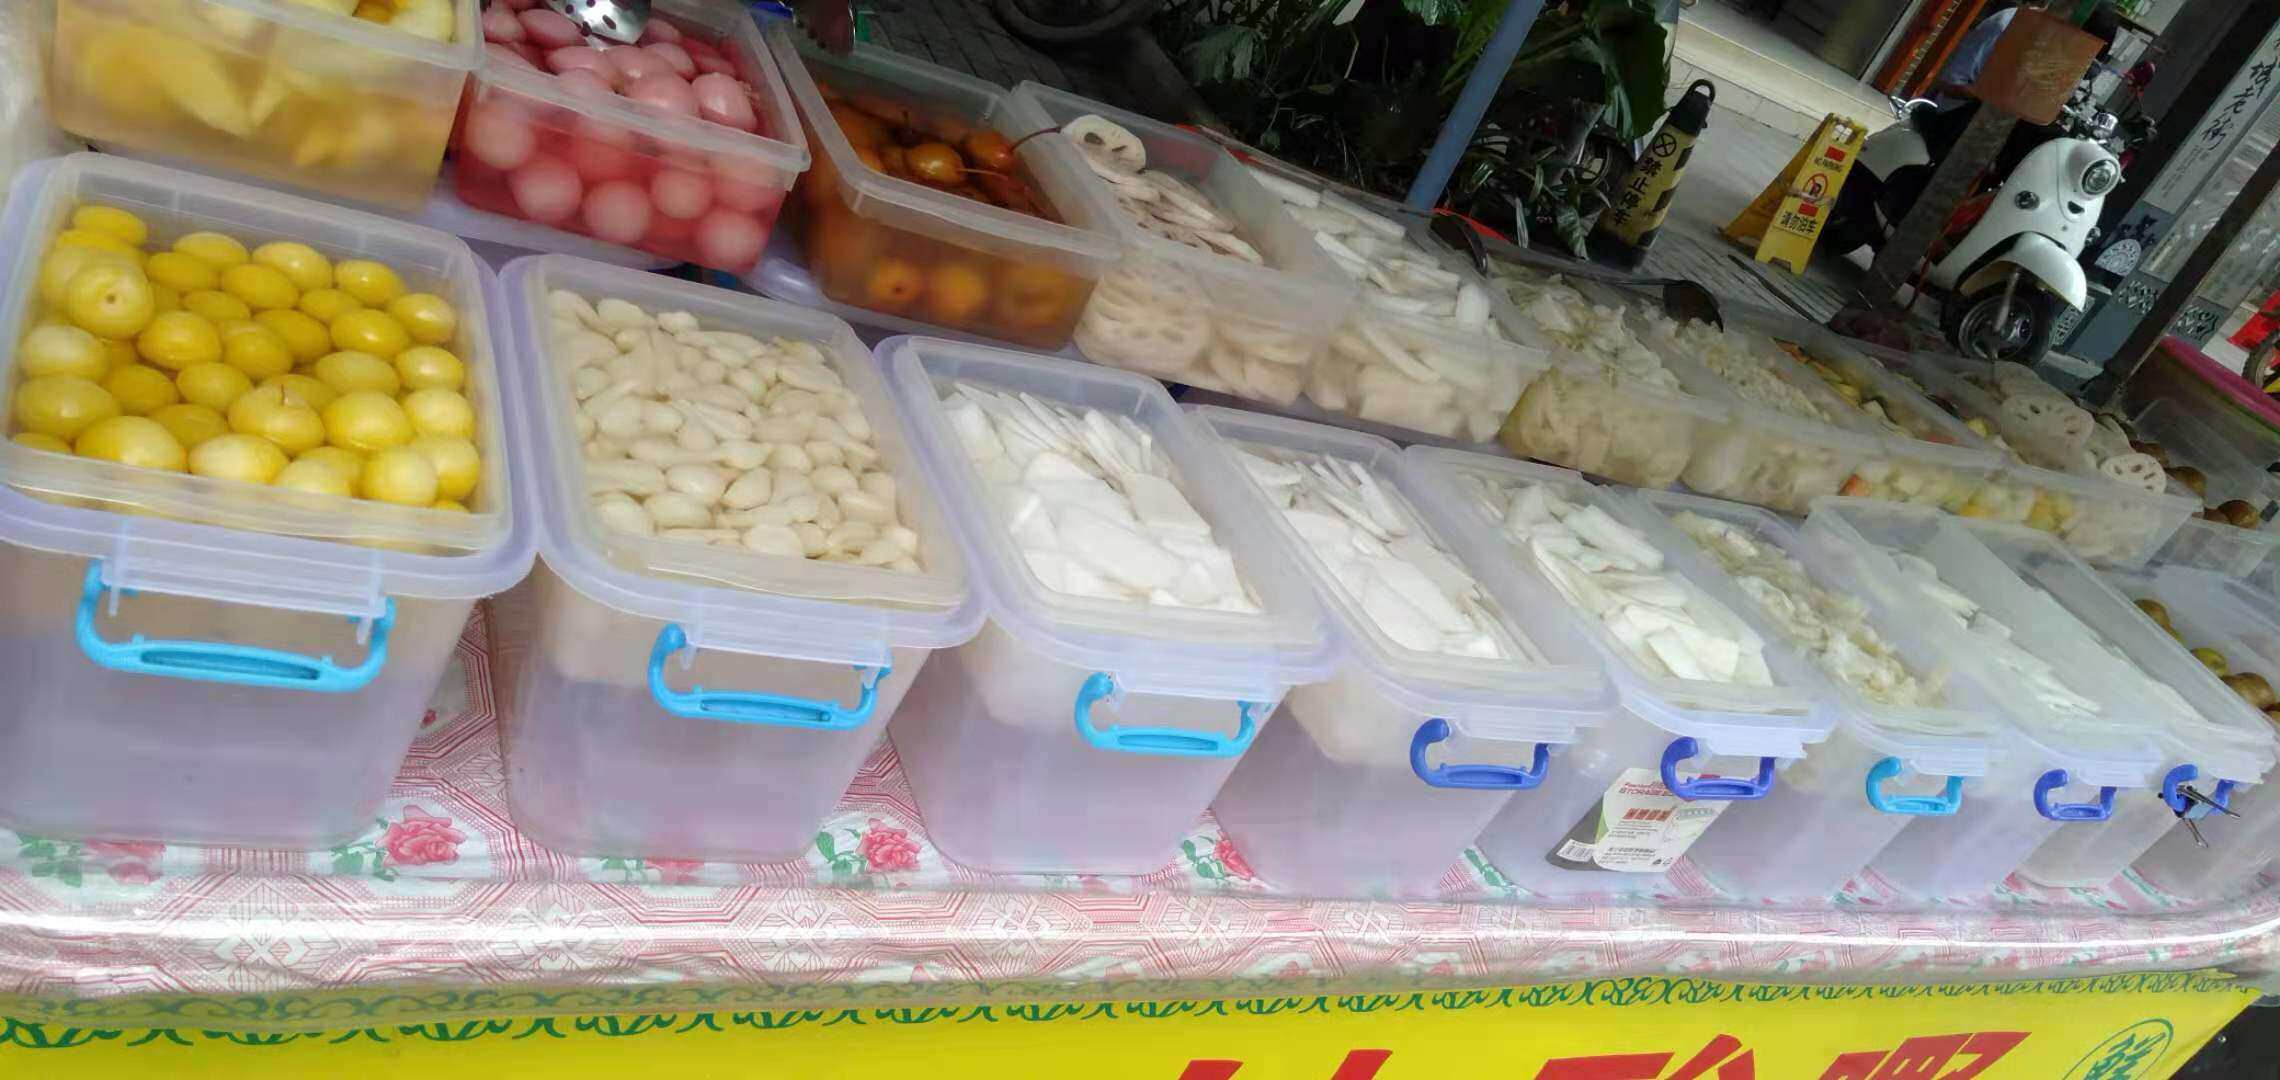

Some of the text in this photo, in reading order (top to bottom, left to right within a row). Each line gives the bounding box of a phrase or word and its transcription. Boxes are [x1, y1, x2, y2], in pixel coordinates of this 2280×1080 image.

[1614, 157, 1663, 225] 禁止停车
[1780, 211, 1818, 233] 请勿泊车
